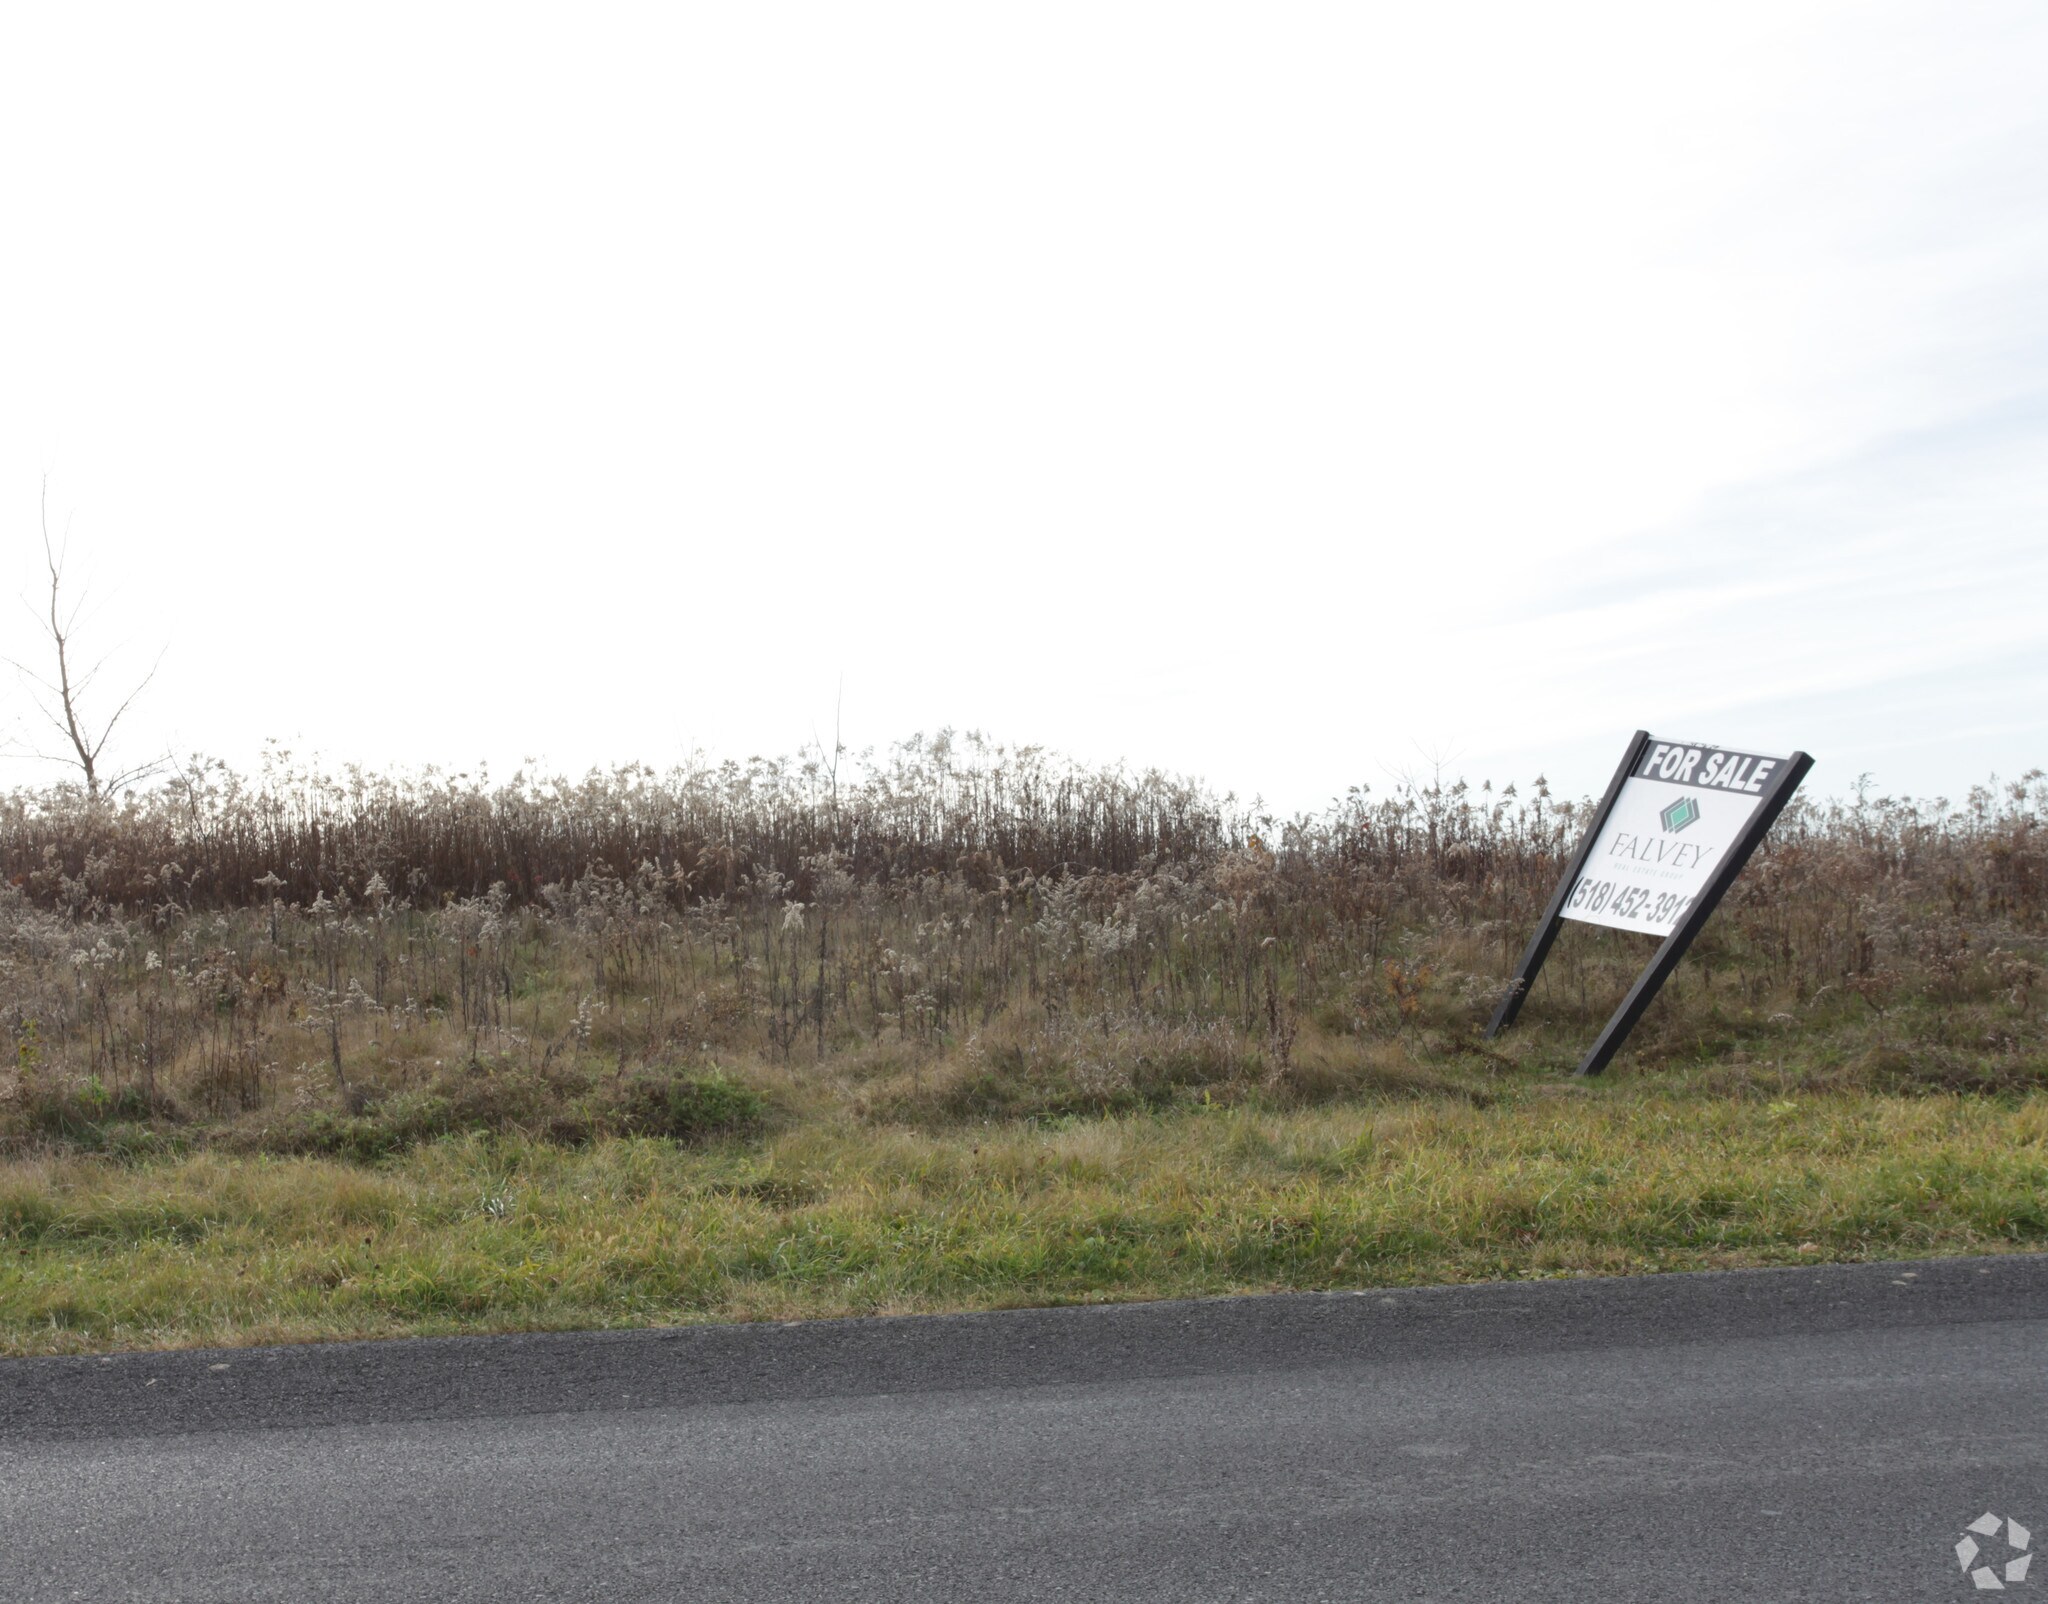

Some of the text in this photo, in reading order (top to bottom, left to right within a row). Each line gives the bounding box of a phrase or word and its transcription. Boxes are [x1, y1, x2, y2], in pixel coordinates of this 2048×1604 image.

[1643, 744, 1776, 793] FOR SALE
[1608, 832, 1714, 869] FALVEY
[1567, 876, 1616, 915] (518)
